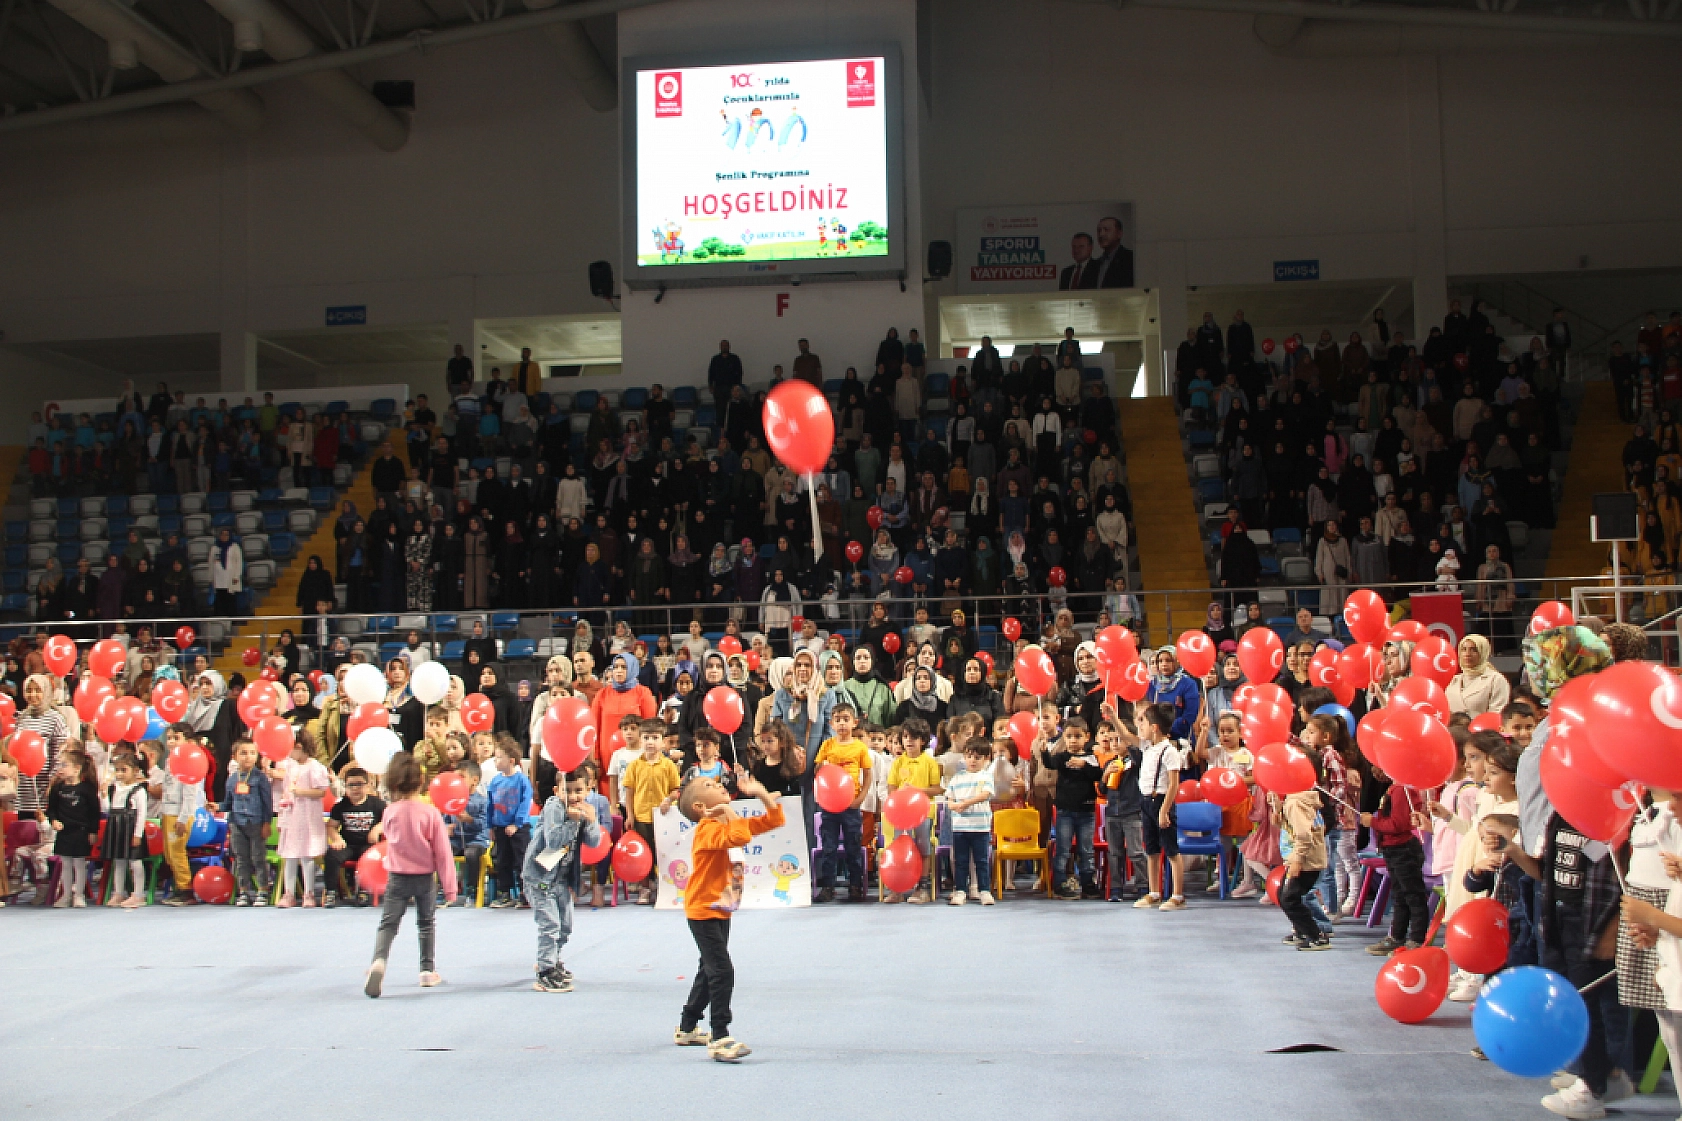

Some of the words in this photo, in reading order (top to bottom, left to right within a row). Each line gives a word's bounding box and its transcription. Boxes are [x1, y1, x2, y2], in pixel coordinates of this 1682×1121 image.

[715, 170, 748, 184] Şenlik
[750, 168, 810, 181] Programına
[684, 182, 848, 219] HOŞGELDİNİZ
[985, 237, 1036, 251] SPORU
[981, 252, 1042, 265] TABANA
[973, 266, 1055, 280] YAYIYORUZ
[776, 293, 790, 318] F
